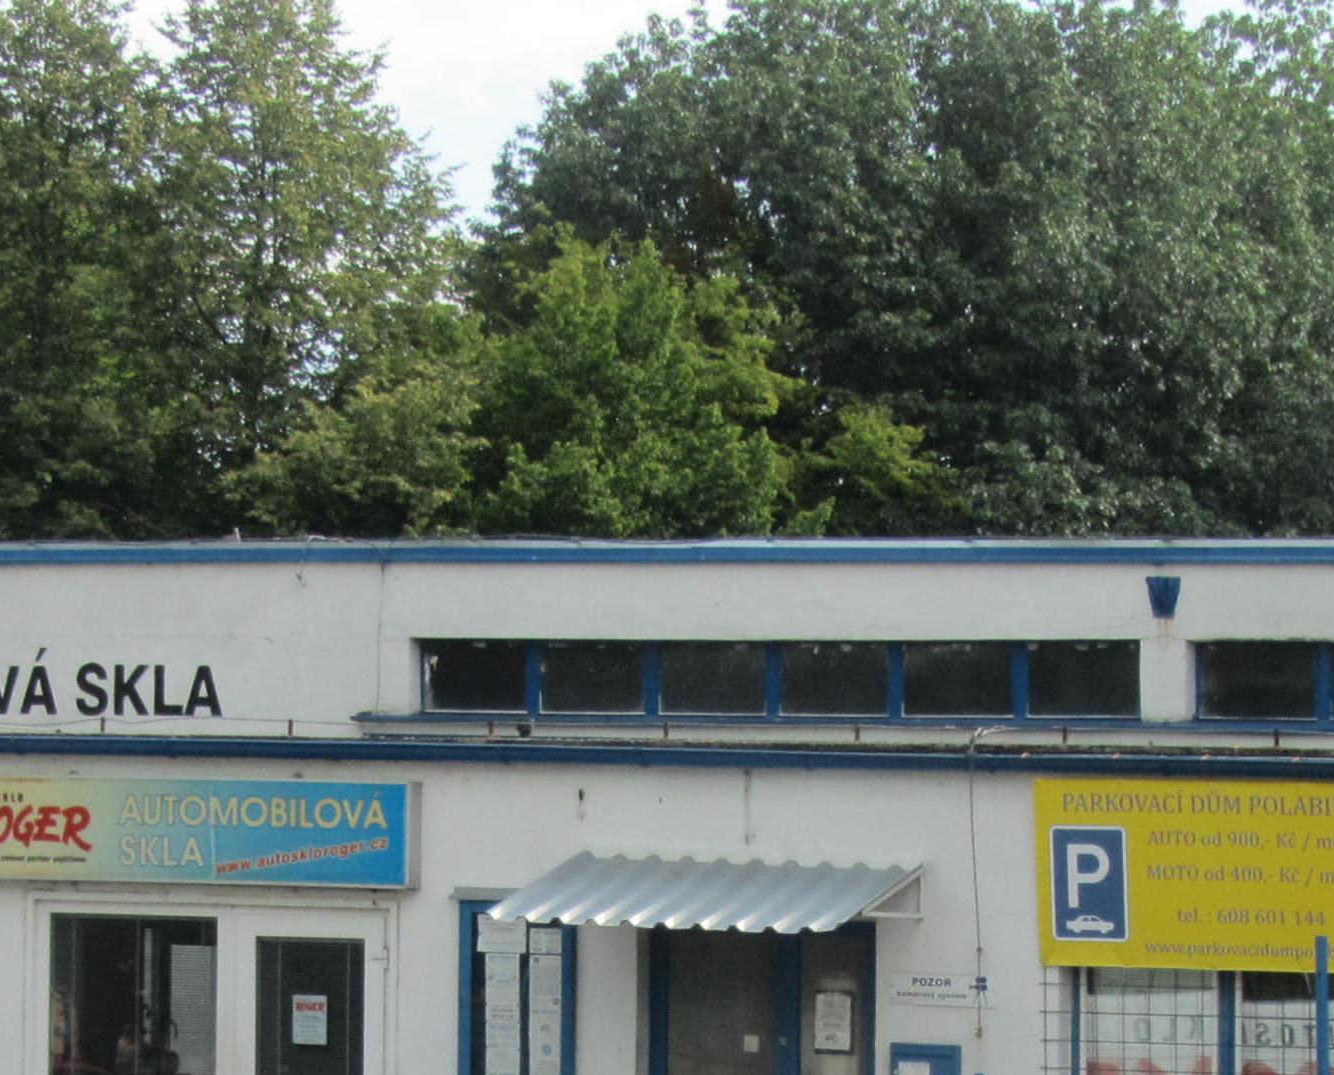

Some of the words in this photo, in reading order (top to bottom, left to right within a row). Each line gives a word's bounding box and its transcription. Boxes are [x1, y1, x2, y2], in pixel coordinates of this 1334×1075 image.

[75, 663, 222, 717] SKLA
[118, 791, 388, 830] AUTOMOBILOVÁ
[1062, 790, 1183, 814] PARKOVACÍ
[1191, 790, 1241, 815] DŮM
[120, 834, 204, 867] SKLA
[1147, 831, 1196, 847] AUTO
[1202, 832, 1221, 847] od
[1276, 832, 1297, 848] Kč
[1067, 843, 1110, 909] P
[1147, 865, 1199, 881] MOTO
[1205, 866, 1225, 881] od
[1279, 867, 1299, 883] Kč
[1217, 908, 1250, 925] 608
[1255, 910, 1286, 925] 601
[1295, 910, 1327, 927] 144
[911, 976, 952, 988] POZOR
